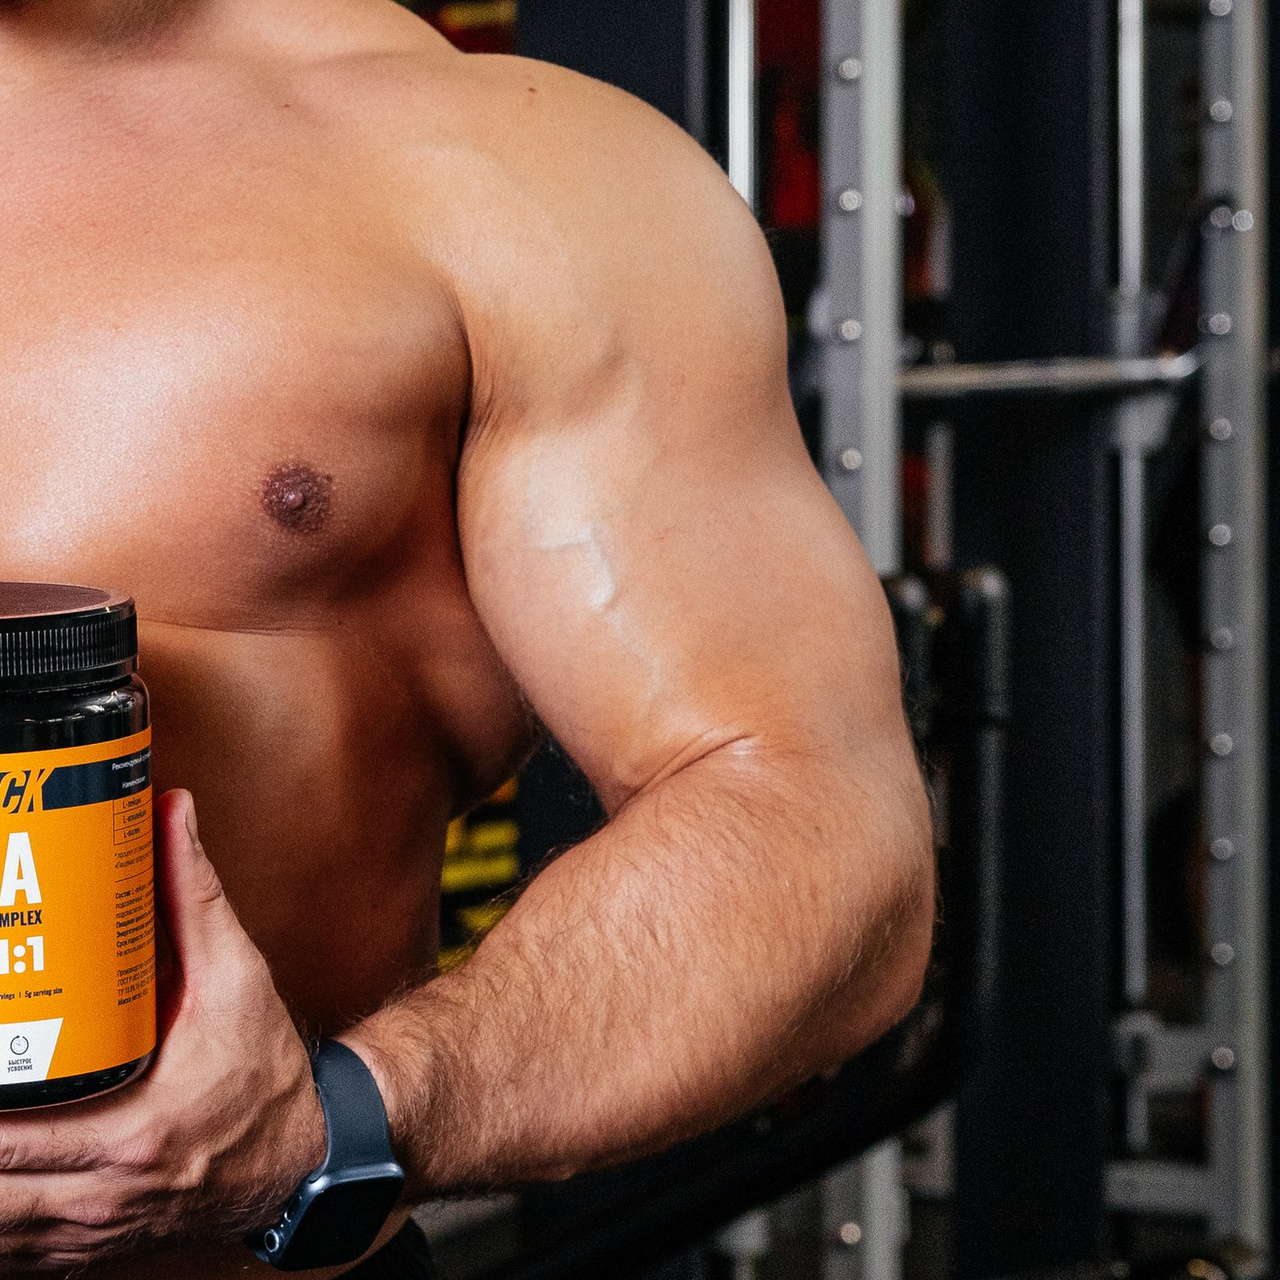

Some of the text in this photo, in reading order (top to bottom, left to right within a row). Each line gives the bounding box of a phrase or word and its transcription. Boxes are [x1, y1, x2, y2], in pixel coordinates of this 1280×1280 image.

[24, 990, 32, 999] 5g
[33, 988, 52, 997] serving
[8, 1058, 32, 1066] БЫСТРОЕ
